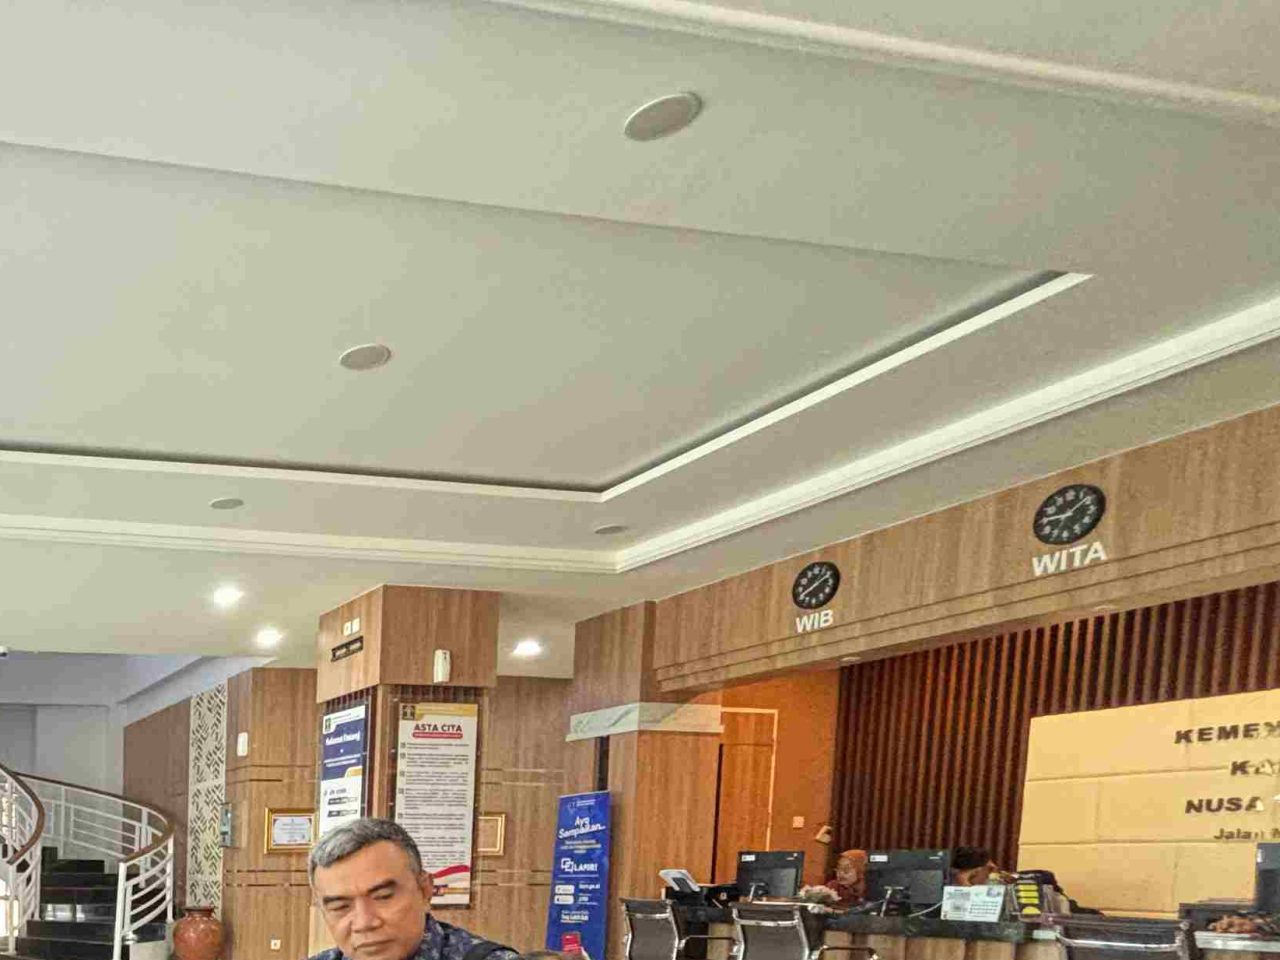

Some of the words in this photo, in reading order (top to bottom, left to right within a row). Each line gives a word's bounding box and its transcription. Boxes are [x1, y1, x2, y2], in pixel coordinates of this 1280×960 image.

[1032, 541, 1107, 577] WITA
[796, 609, 834, 633] WIB
[414, 723, 439, 732] ASTA
[441, 723, 463, 732] CITA
[1185, 796, 1264, 814] NUSA
